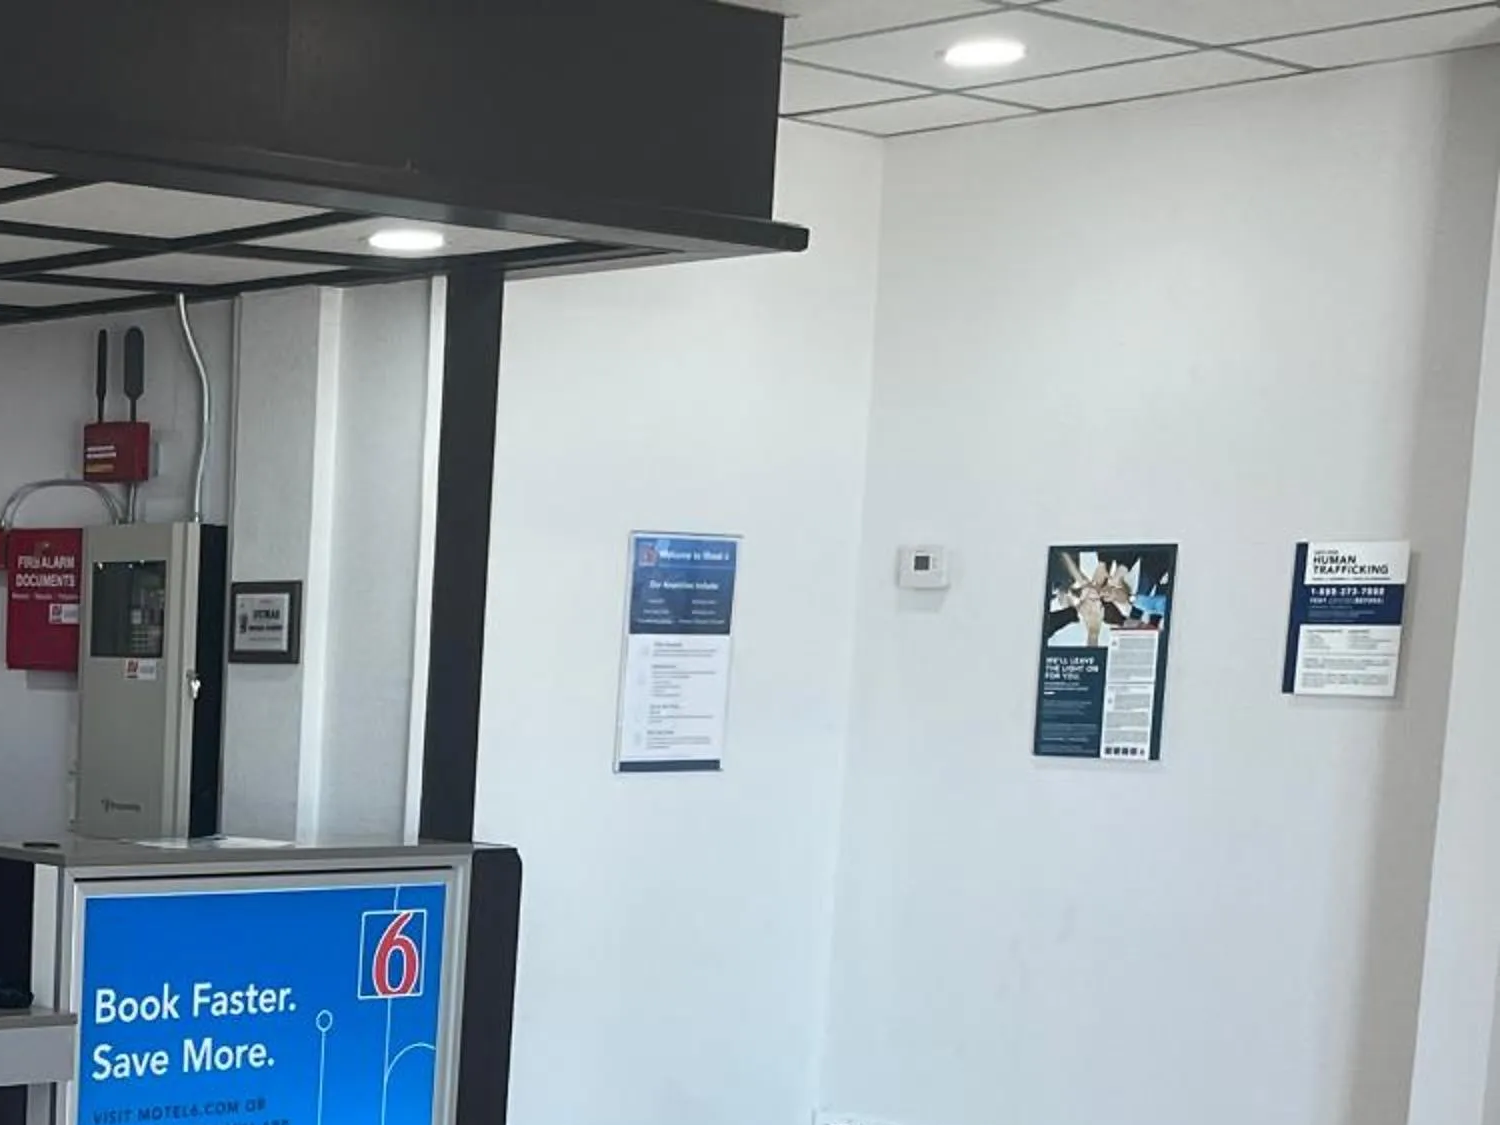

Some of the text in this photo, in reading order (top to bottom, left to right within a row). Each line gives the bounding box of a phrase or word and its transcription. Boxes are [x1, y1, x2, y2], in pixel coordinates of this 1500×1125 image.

[41, 555, 74, 569] ALARM
[1312, 564, 1389, 575] TRAFFICKING
[1313, 555, 1357, 564] HUMAN
[15, 573, 75, 588] DOCUMENTS
[371, 911, 419, 997] 6
[95, 982, 297, 1025] Book Faster.
[92, 1037, 275, 1081] Save More.
[93, 1097, 267, 1125] VISIT MOTEL6.COM OR
